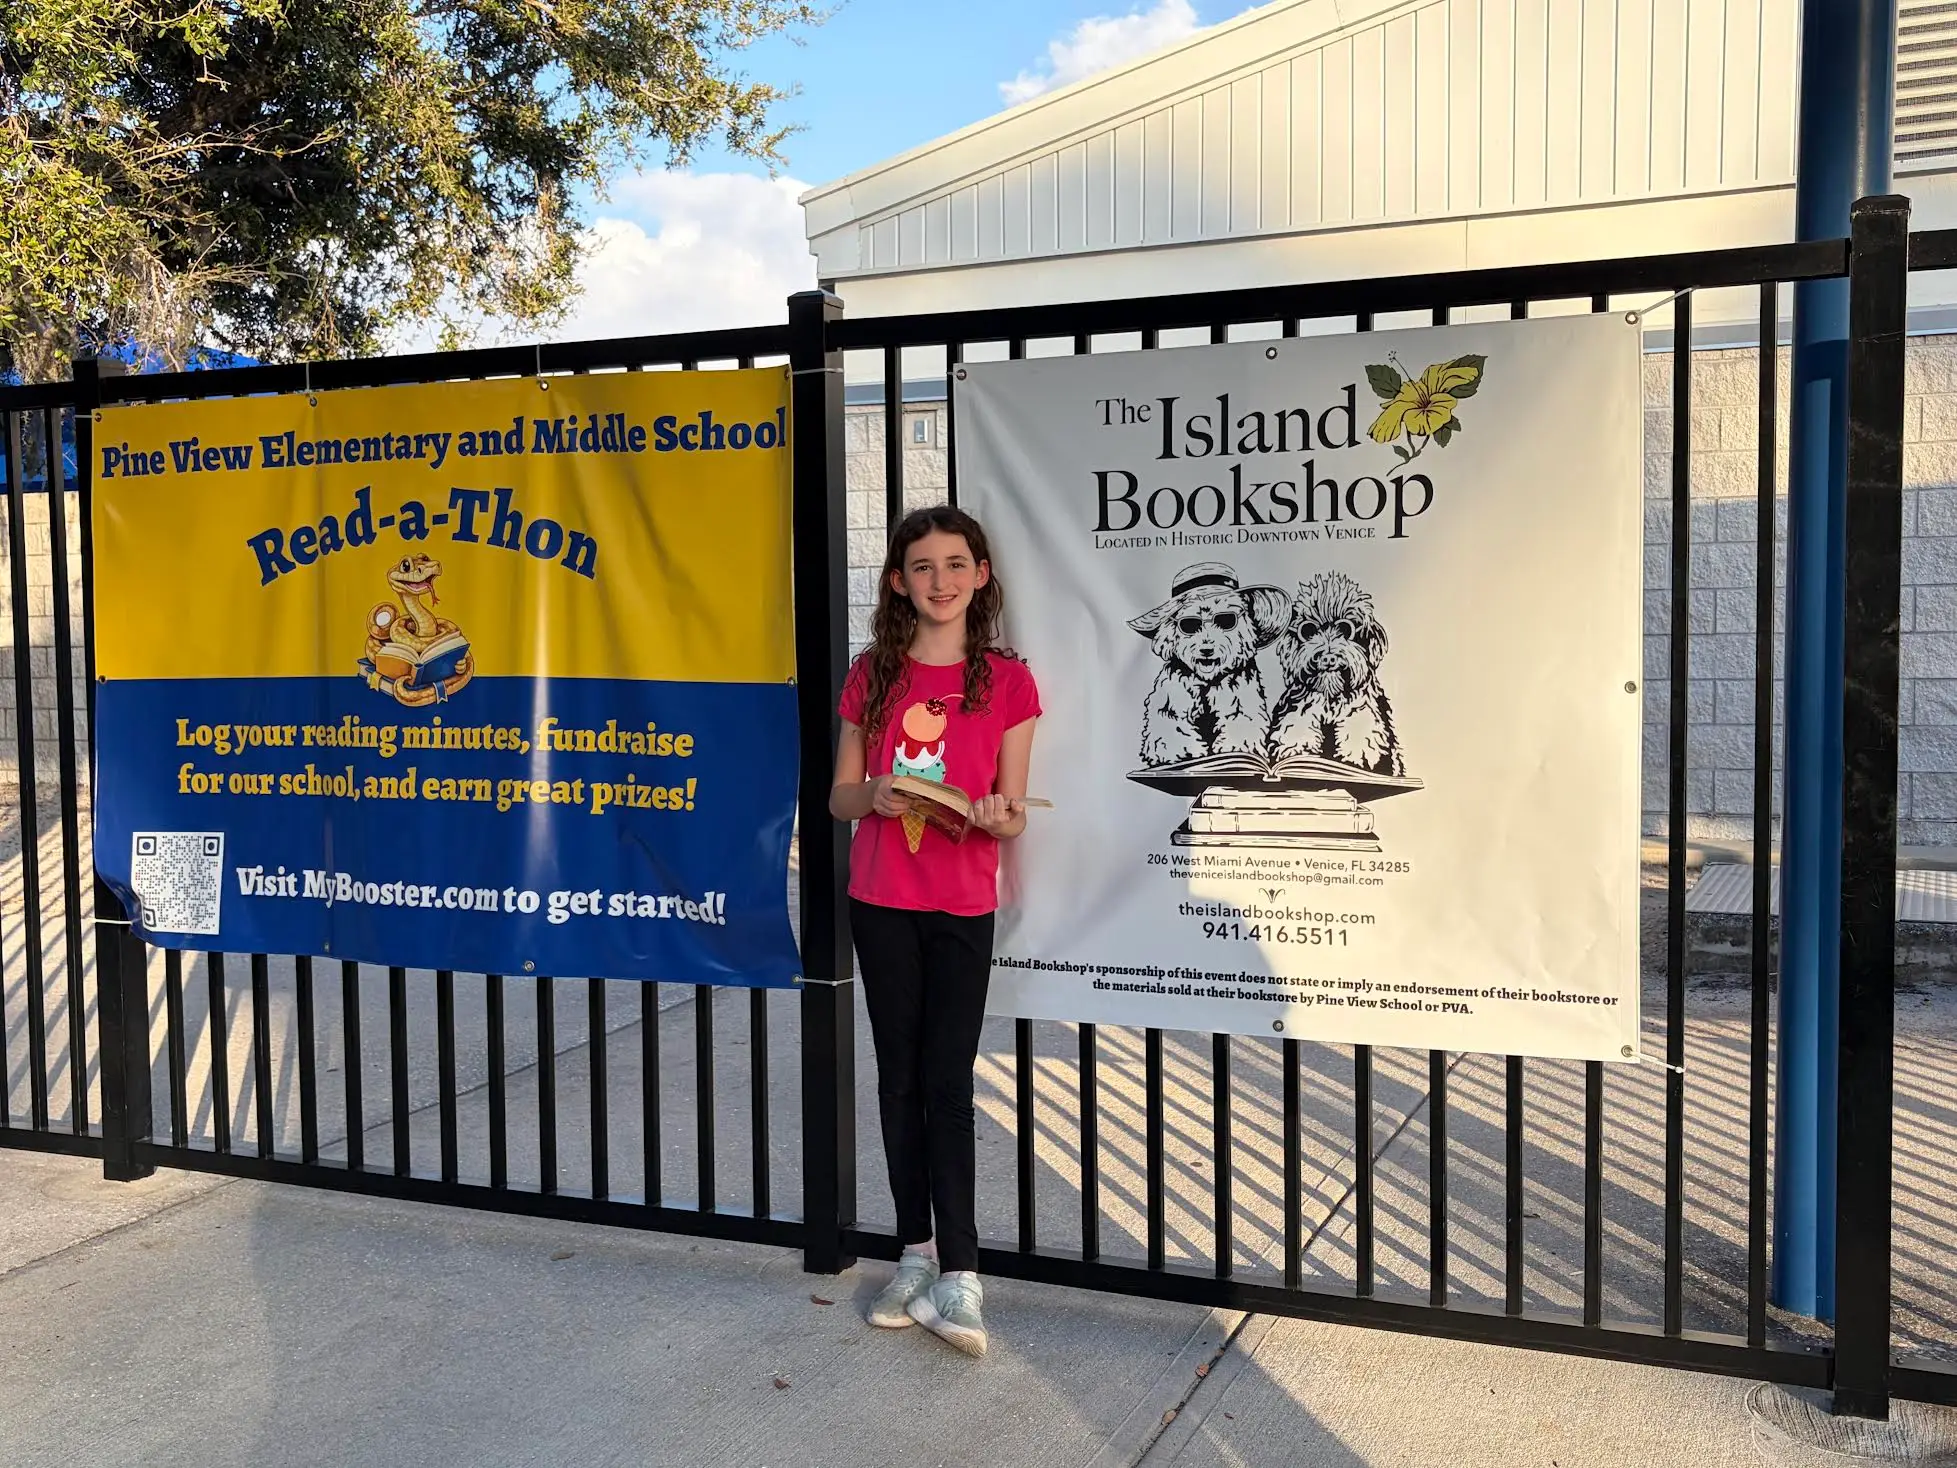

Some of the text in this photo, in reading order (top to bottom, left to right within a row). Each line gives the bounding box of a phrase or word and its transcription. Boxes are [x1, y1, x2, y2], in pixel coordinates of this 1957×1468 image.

[101, 406, 786, 478] Pine View Elementary and Middle School
[1096, 383, 1362, 460] The Island
[1091, 459, 1434, 539] Bookshop
[247, 485, 598, 587] Read-a-Thon
[176, 715, 695, 758] Log your reading minutes, fundraise
[178, 762, 698, 814] for our school, and earn great prizes!
[1147, 854, 1410, 873] 206 West Miami Avenue Venice, FL 34285
[1170, 869, 1384, 886] theveniceislandbookshop@gmail.com
[236, 865, 727, 925] Visit MyBooster.com to get started!
[1179, 902, 1375, 926] theislandbookshop.com
[1202, 922, 1348, 946] 941.416.5511
[998, 957, 1032, 969] Island
[1033, 960, 1094, 975] Bookshop's
[1096, 965, 1166, 980] sponsorship
[1167, 967, 1181, 978] of
[1181, 969, 1203, 980] this
[1205, 971, 1236, 982] event
[1238, 971, 1266, 984] does
[1267, 976, 1288, 985] not
[1290, 977, 1319, 987] state
[1321, 979, 1336, 988] or
[1338, 978, 1373, 993] imply
[1375, 982, 1391, 992] an
[1393, 983, 1479, 997] endorsement
[1481, 986, 1497, 998] of
[1497, 988, 1530, 1001] their
[1532, 990, 1600, 1005] bookstore
[1603, 996, 1618, 1005] or
[1093, 979, 1473, 1014] the materials sold at their bookstore by Pine View School or PVA.
